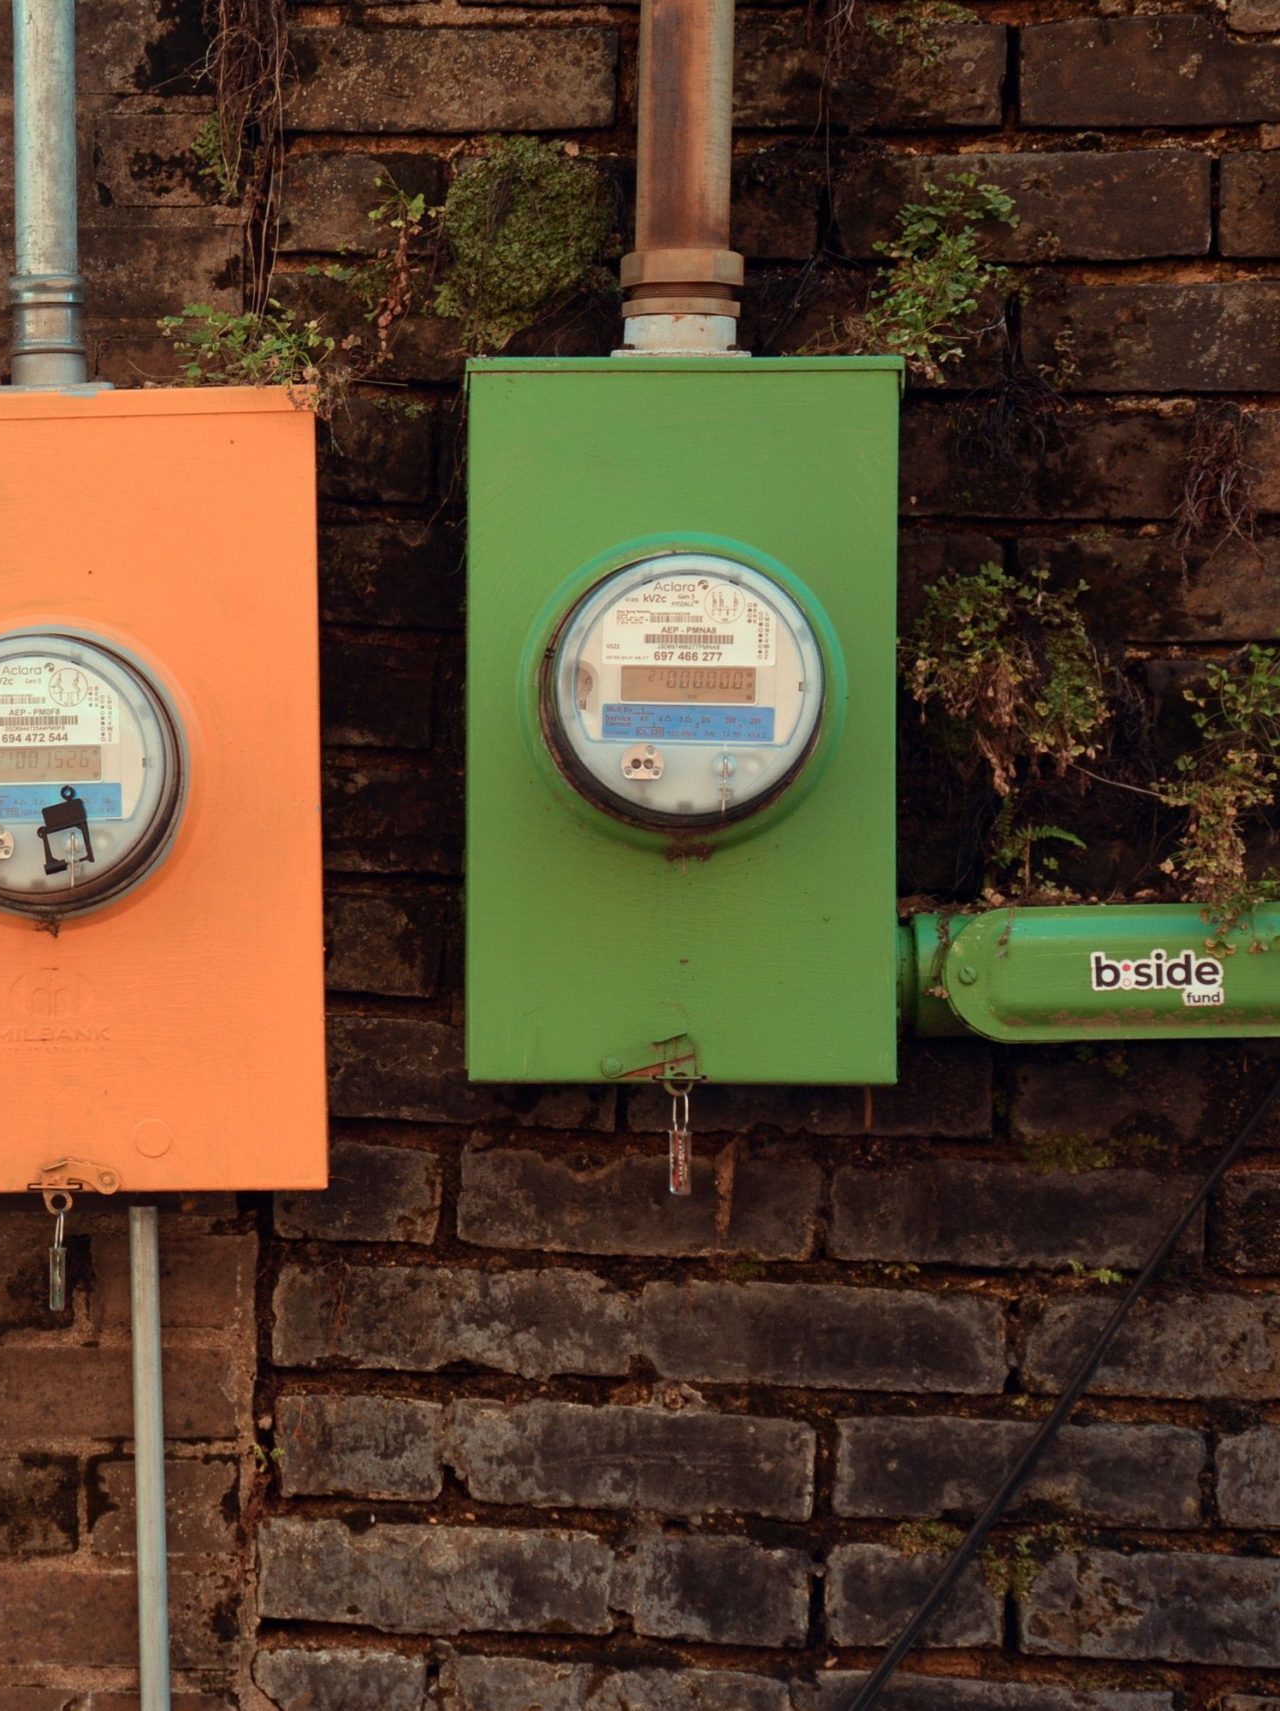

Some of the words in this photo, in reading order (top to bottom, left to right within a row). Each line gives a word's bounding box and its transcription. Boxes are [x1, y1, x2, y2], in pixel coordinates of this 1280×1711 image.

[654, 581, 696, 592] Aclara
[643, 593, 667, 603] kV2c
[661, 626, 679, 634] AEP
[654, 651, 674, 661] 697
[678, 651, 698, 661] 466
[702, 652, 723, 662] 277
[2, 665, 42, 676] Aclara
[9, 708, 26, 716] AEP
[1, 733, 22, 743] 694
[25, 733, 45, 743] 472
[48, 732, 69, 742] 544
[1186, 991, 1221, 1004] fund
